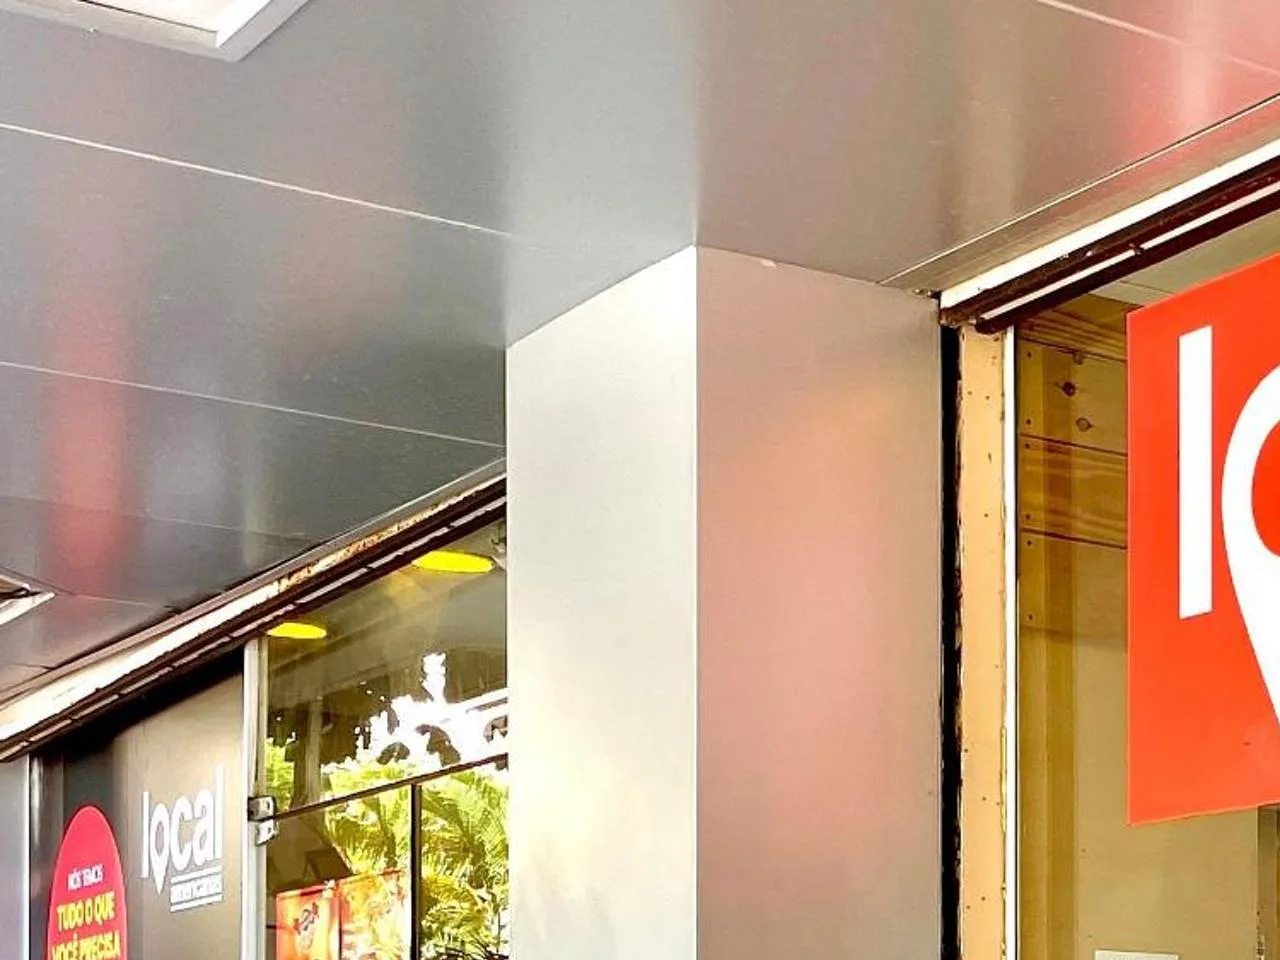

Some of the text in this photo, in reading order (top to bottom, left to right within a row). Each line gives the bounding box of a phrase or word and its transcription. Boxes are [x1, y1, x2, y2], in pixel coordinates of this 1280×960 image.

[142, 763, 224, 897] local
[56, 890, 115, 932] TUDO O QUE
